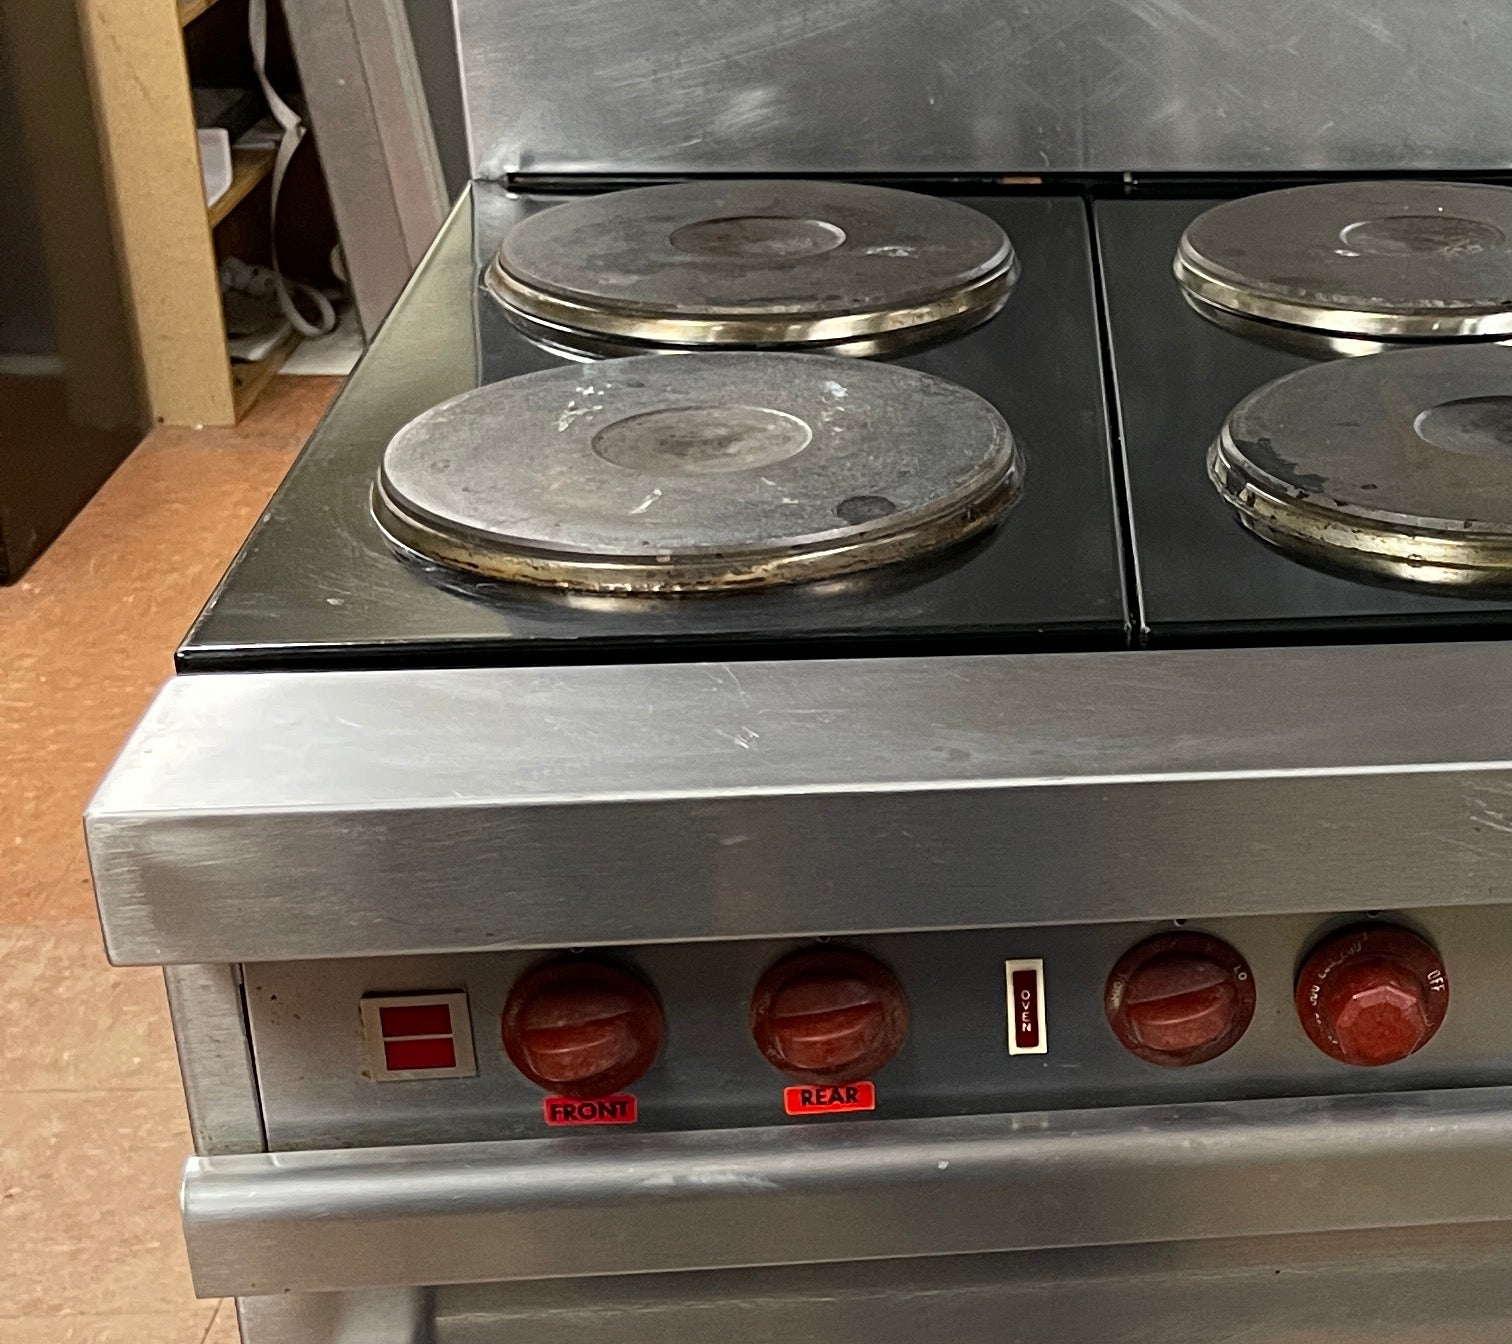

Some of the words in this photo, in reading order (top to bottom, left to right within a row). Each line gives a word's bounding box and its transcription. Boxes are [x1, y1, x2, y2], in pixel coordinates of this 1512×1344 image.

[1427, 969, 1446, 992] OFF
[1020, 989, 1032, 1033] OVEN
[801, 1087, 860, 1107] REAR
[551, 1100, 629, 1123] FRONT
